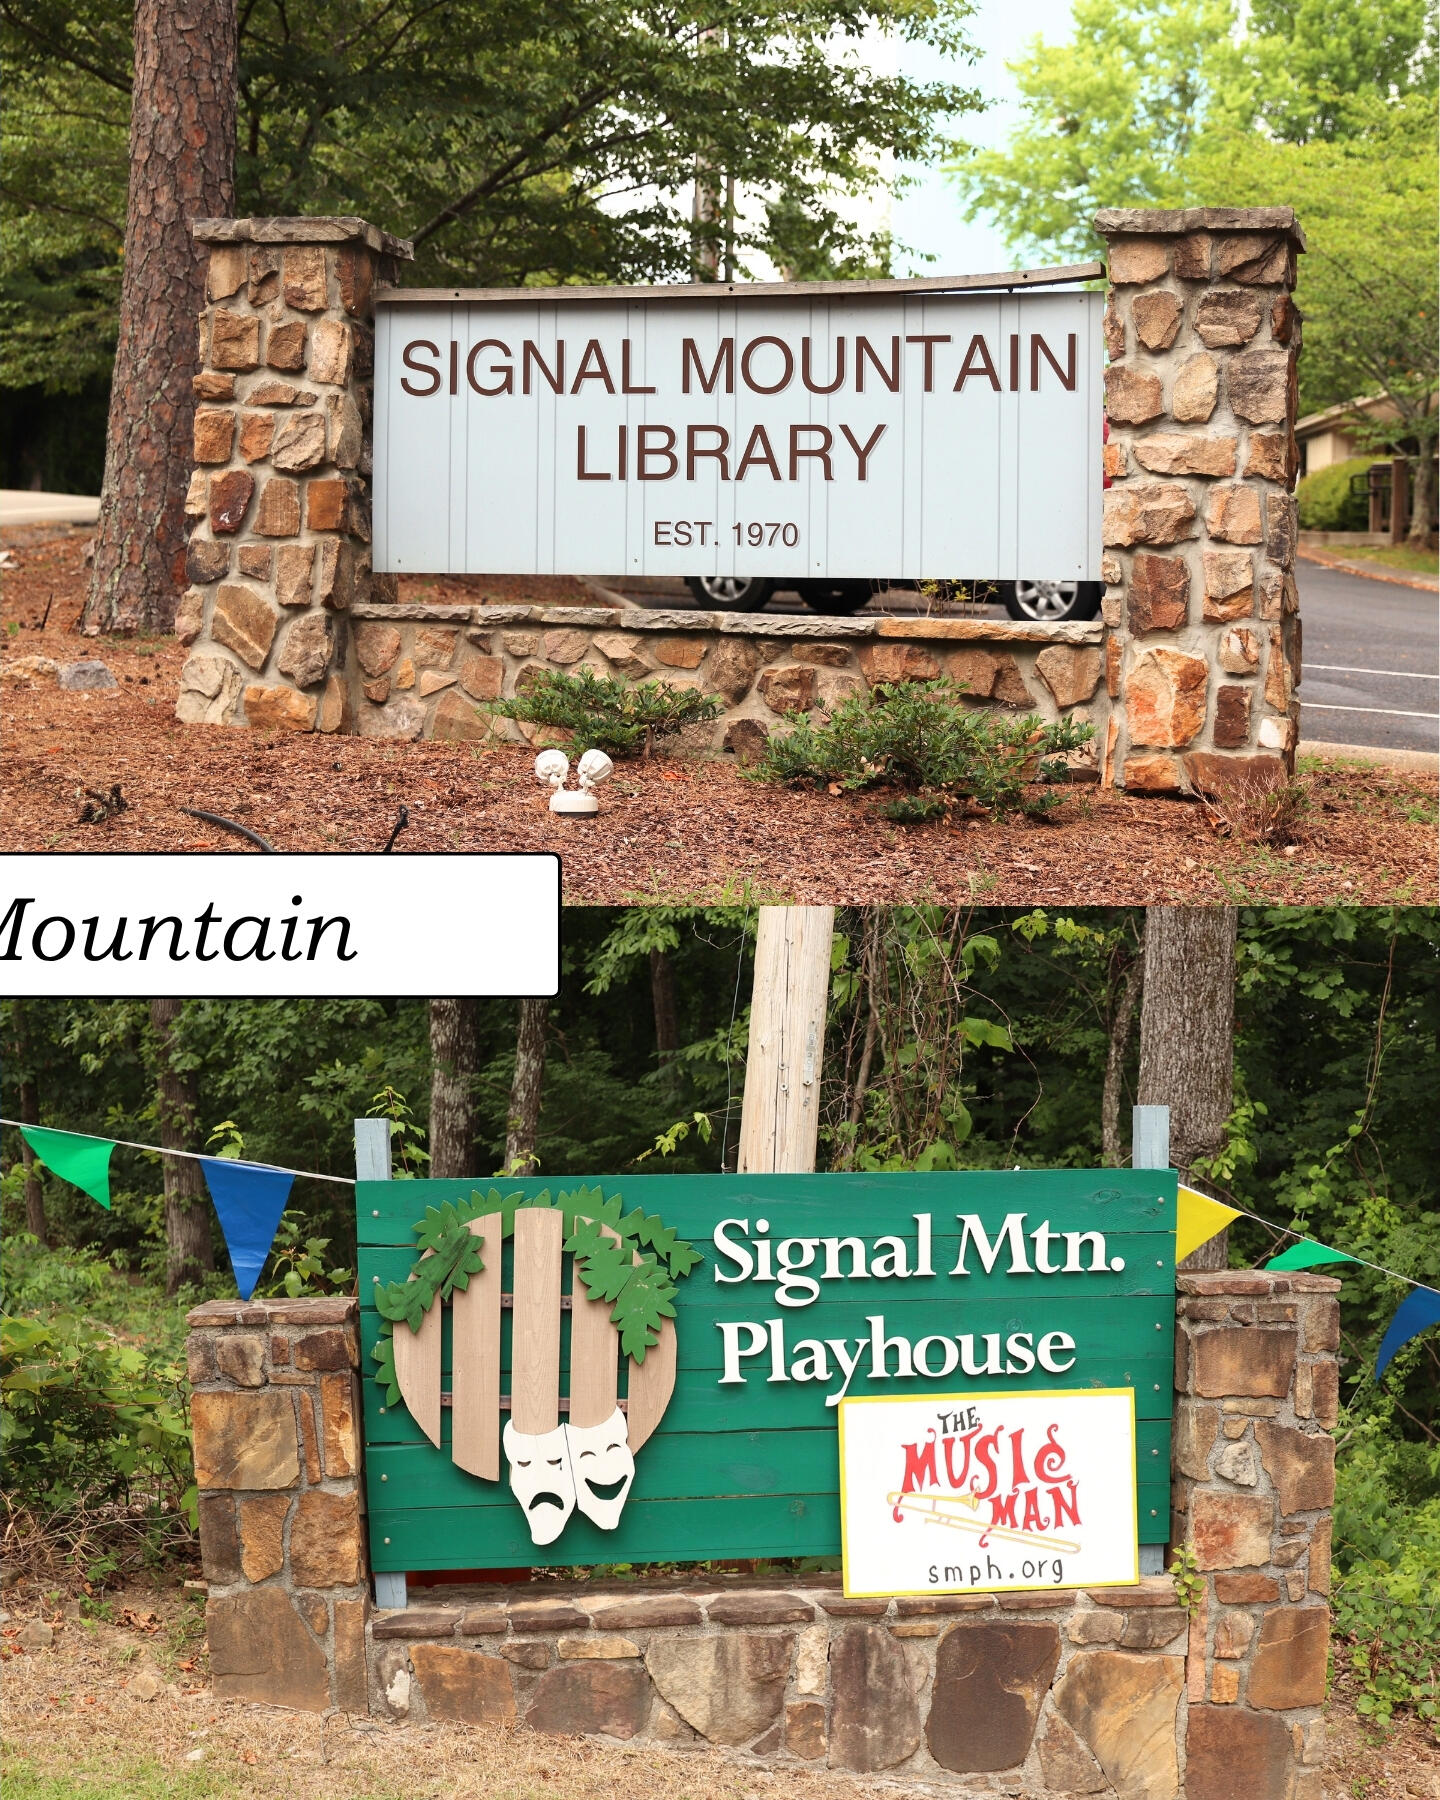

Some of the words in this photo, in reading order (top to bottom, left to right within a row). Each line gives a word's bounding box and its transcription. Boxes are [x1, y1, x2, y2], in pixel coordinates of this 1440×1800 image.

[400, 338, 656, 397] SIGNAL
[681, 333, 1078, 394] MOUNTAIN
[576, 424, 887, 481] LIBRARY
[653, 521, 719, 547] EST.
[732, 522, 799, 547] 1970
[713, 1213, 936, 1307] Signal
[949, 1213, 1125, 1275] Mtn.
[716, 1315, 1076, 1407] Playhouse
[937, 1407, 980, 1434] THE
[979, 1480, 1081, 1548] MAN
[929, 1556, 1064, 1585] smph.org
